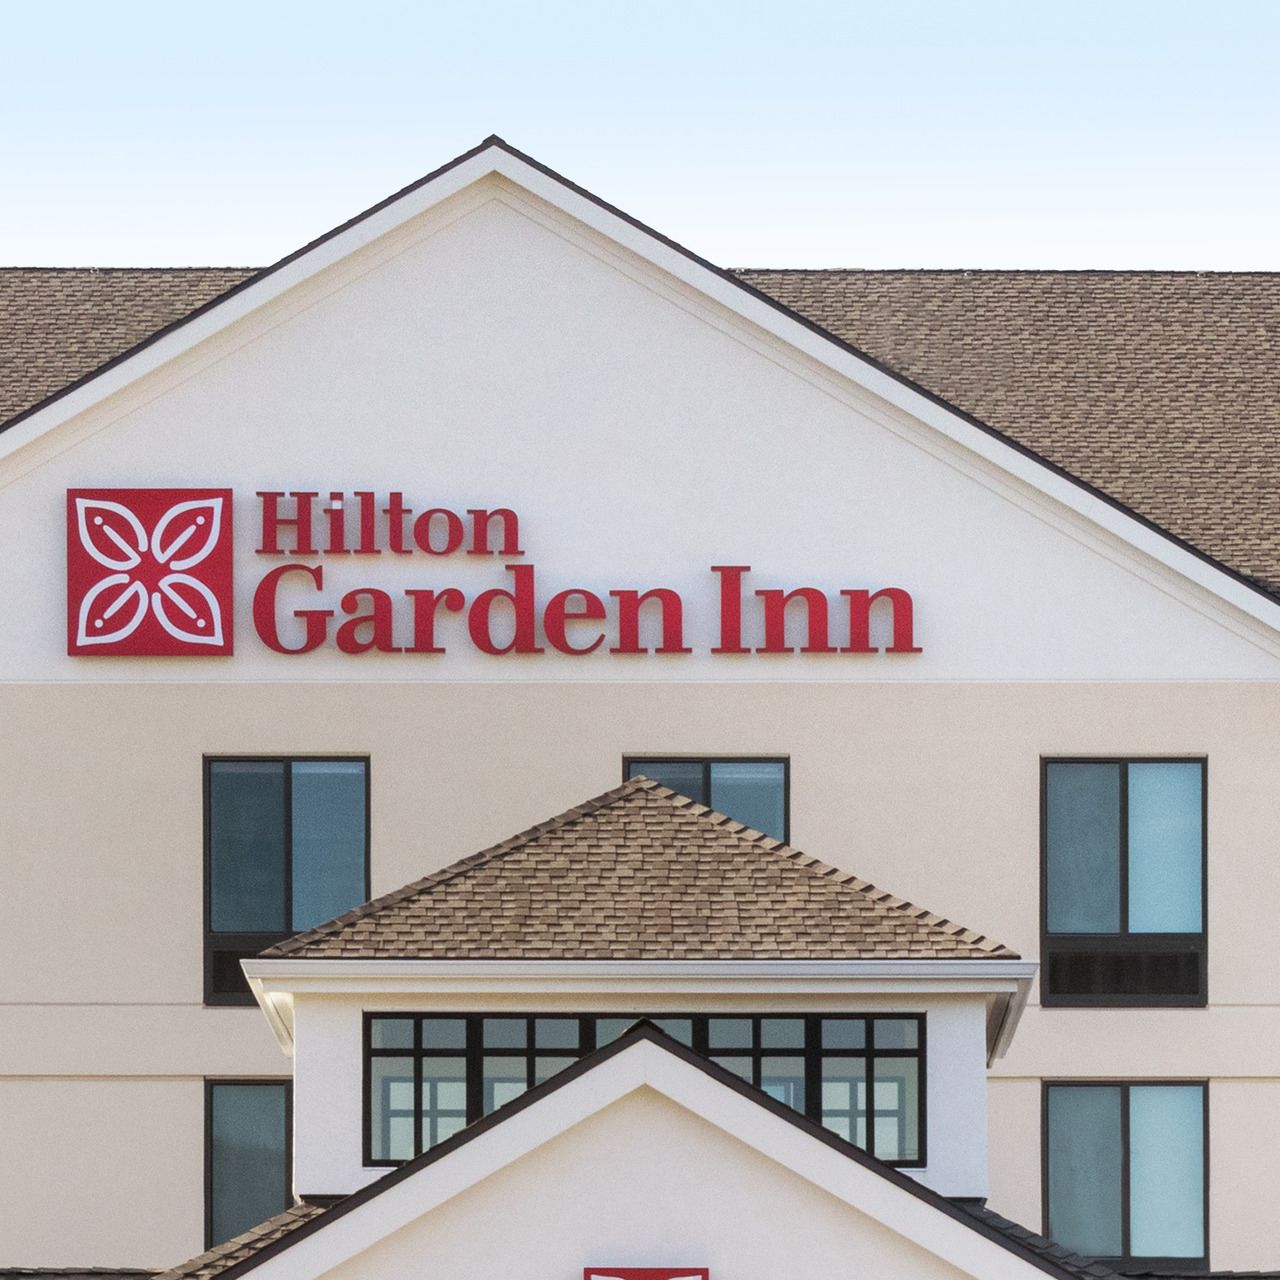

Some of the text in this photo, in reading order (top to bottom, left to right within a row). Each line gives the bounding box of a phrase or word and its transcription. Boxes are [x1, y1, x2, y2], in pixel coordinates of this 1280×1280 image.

[255, 491, 525, 557] Hilton
[252, 564, 923, 656] Garden Inn
